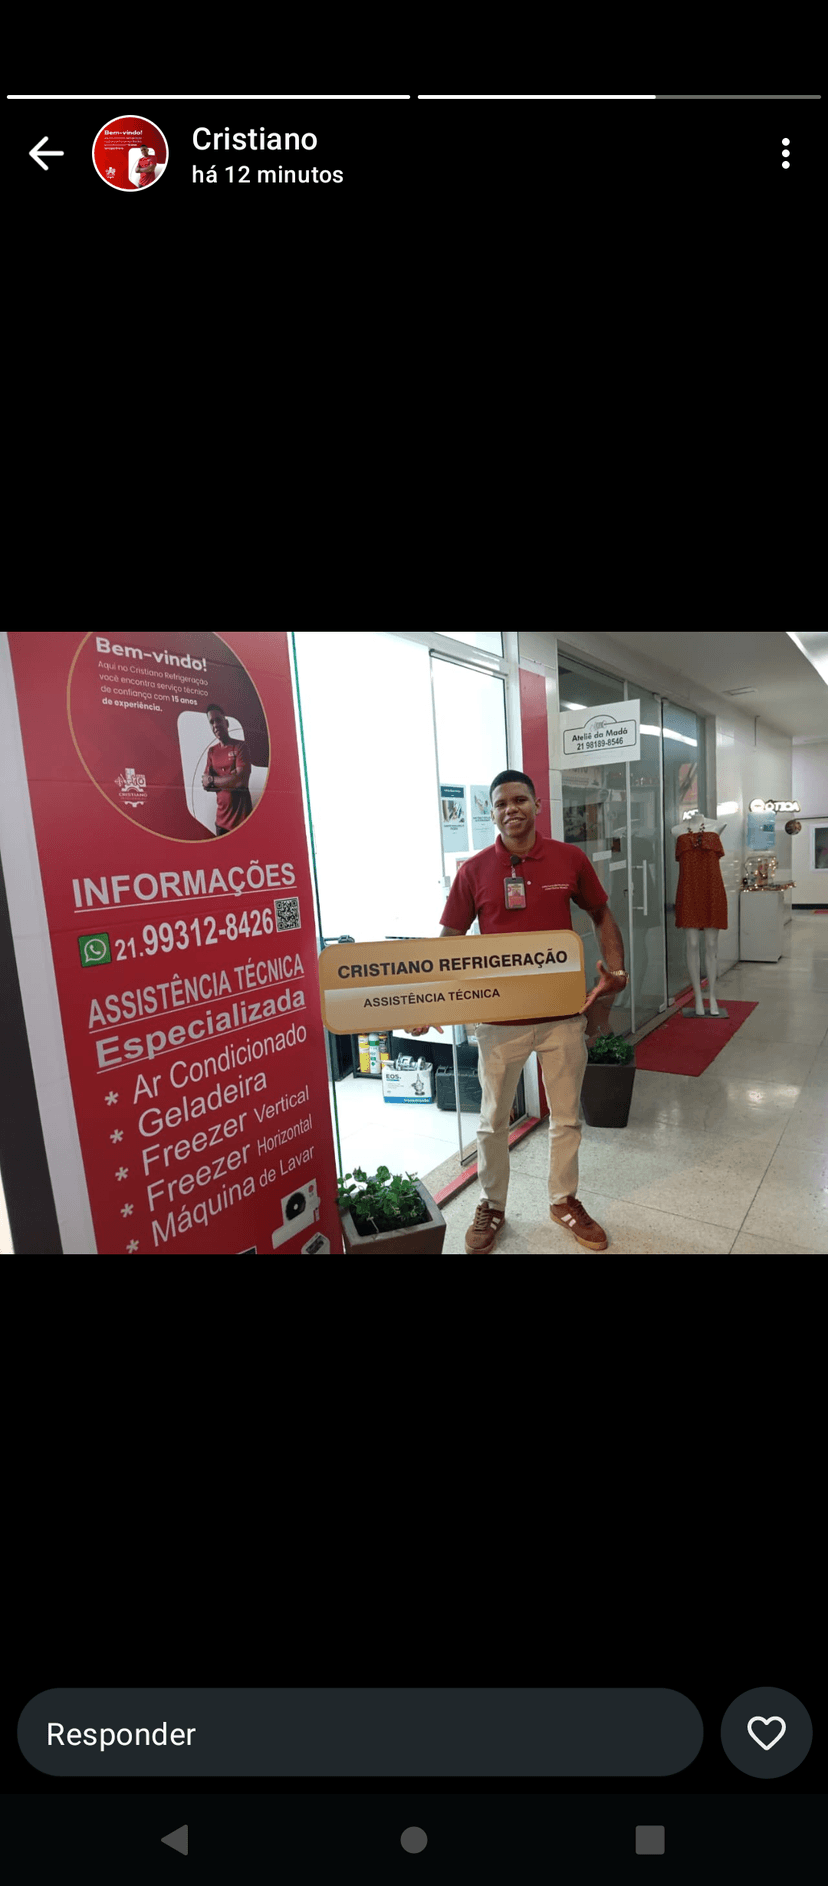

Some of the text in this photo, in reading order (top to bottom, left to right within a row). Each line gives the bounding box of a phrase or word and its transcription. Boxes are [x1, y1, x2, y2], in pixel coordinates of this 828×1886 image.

[95, 636, 207, 672] Bem-vindo!
[98, 661, 208, 686] Aqui no Cristiano Refrigeração
[99, 673, 208, 697] você encontra serviço técnico
[101, 685, 198, 706] de confiança com 15 anos
[102, 697, 163, 712] de experiência.
[572, 728, 628, 742] Ateliê da Madá
[586, 737, 624, 749] 98189-8546
[72, 860, 295, 907] INFORMAÇÕES
[115, 908, 273, 961] 21.99312-8426
[337, 949, 568, 979] CRISTIANO REFRIGERAÇÃO
[88, 953, 304, 1028] ASSISTÊNCIA TÉCNICA
[363, 988, 500, 1008] ASSISTÊNCIA TÉCNICA
[95, 988, 306, 1069] Especializada
[133, 1025, 307, 1104] Ar Condicionado
[138, 1072, 267, 1138] Geladeira
[142, 1085, 310, 1176] Freezer Vertical
[147, 1114, 313, 1212] Freezer Horizontal
[152, 1145, 314, 1247] Máquina de Lavar
